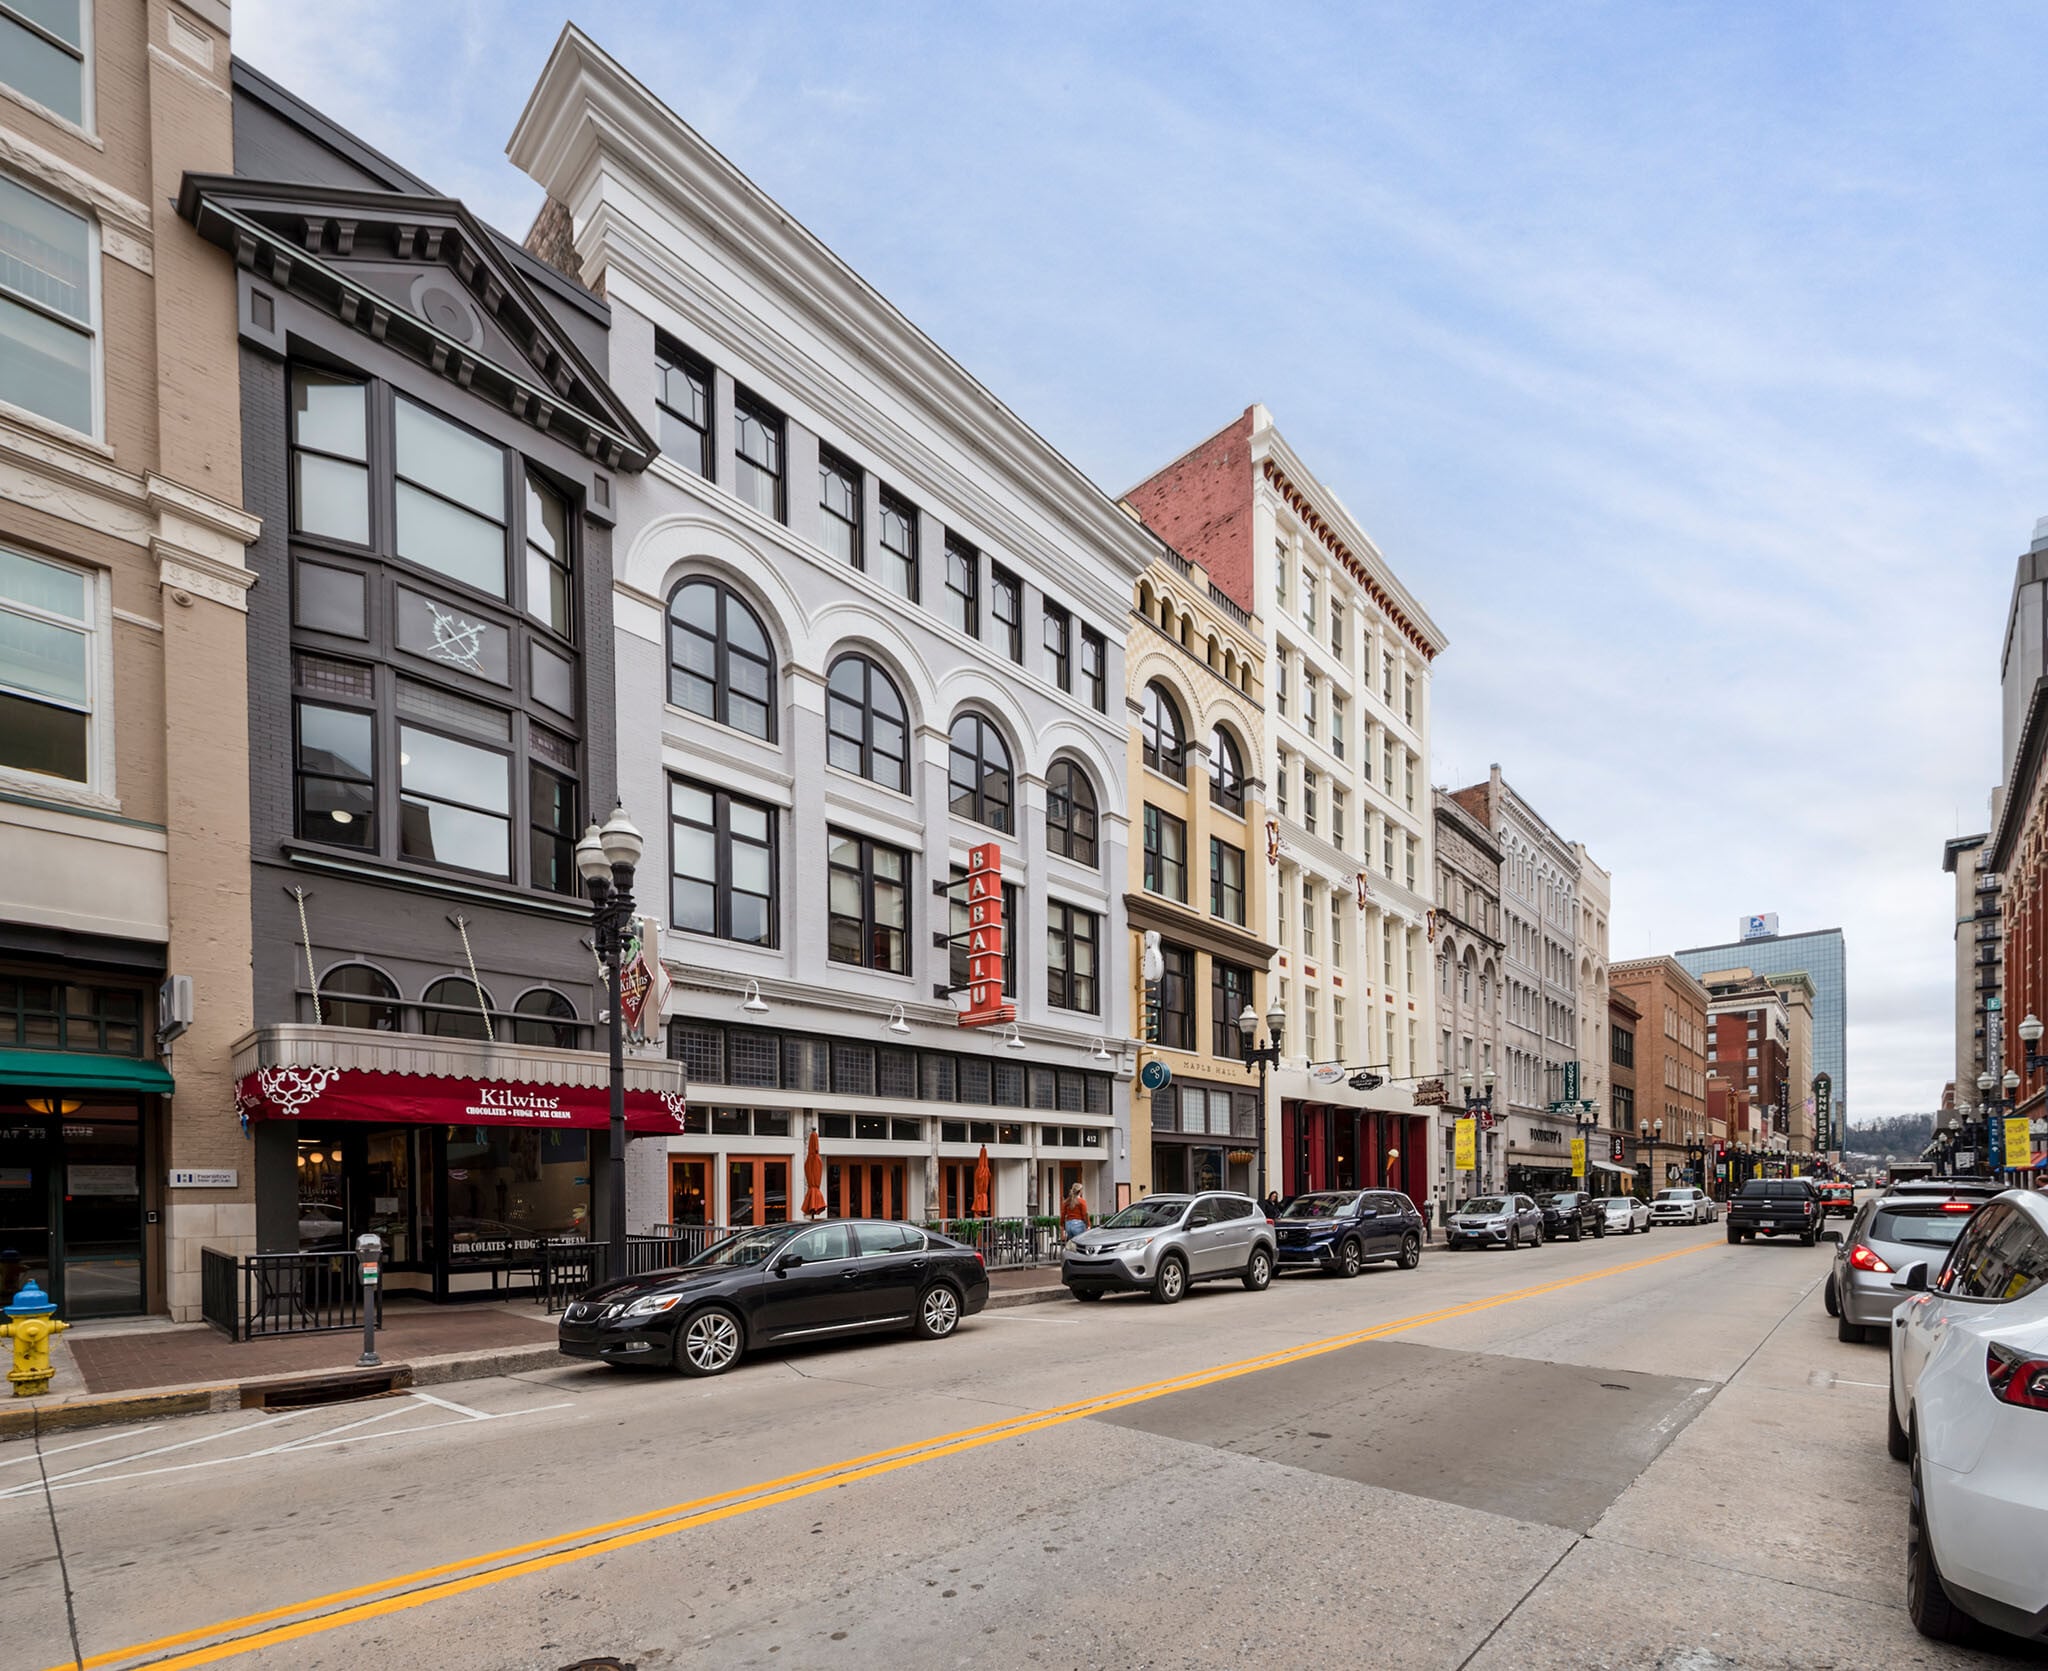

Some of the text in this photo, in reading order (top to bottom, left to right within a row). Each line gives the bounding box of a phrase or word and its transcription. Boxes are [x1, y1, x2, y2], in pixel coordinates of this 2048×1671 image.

[972, 851, 987, 1004] BABALU
[1183, 1061, 1237, 1077] MAPLE HALL
[480, 1088, 559, 1109] Kilwins
[465, 1106, 571, 1119] CHOCOLATES FUDGE ICE CREAM
[1818, 1081, 1826, 1150] TENNESSEE
[1086, 1135, 1097, 1143] 412
